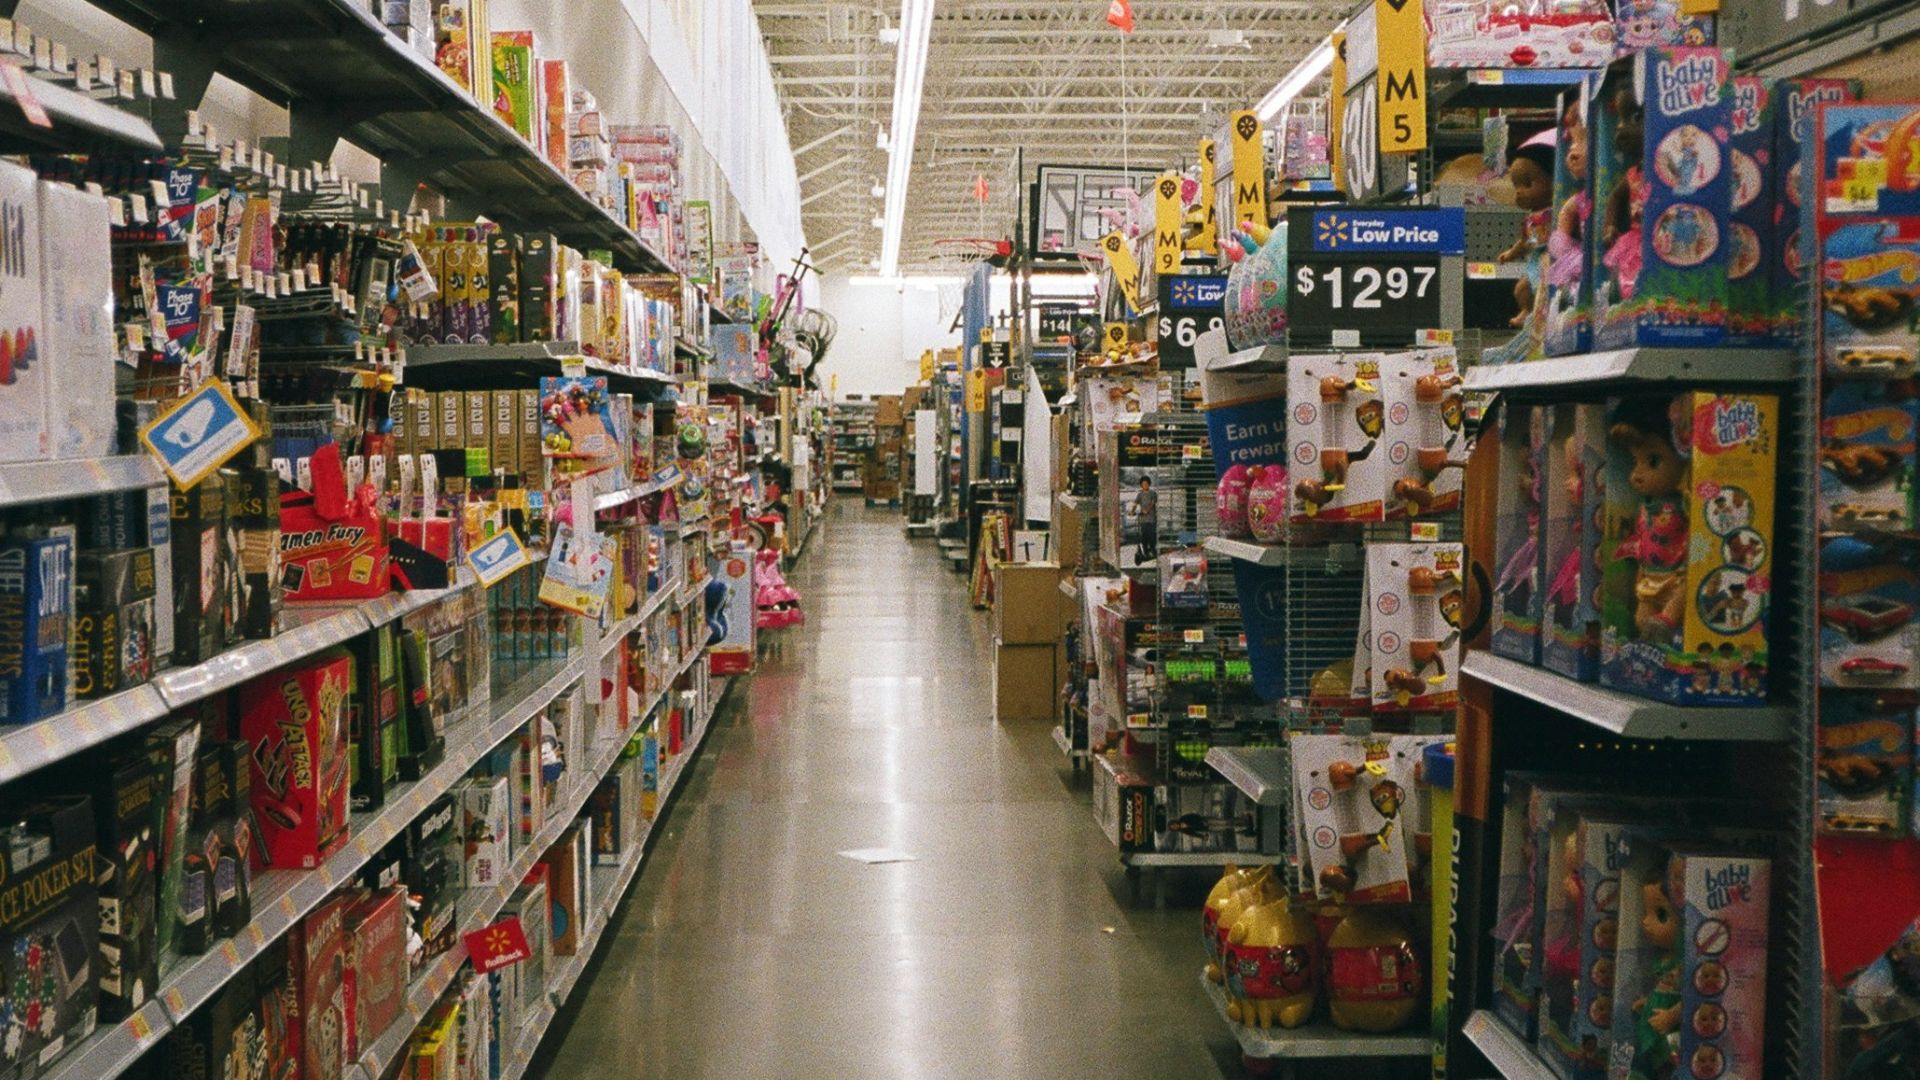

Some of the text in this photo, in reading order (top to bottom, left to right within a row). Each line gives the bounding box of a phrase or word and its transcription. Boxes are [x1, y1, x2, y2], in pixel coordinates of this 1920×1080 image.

[1660, 57, 1714, 88] baby
[1384, 69, 1418, 102] M
[1394, 114, 1411, 143] 5
[169, 169, 193, 185] Phase
[174, 184, 189, 197] 10
[1238, 182, 1260, 205] M
[1352, 219, 1385, 228] Everyday
[1158, 231, 1177, 248] M
[1352, 227, 1439, 243] Low Price
[1163, 254, 1173, 269] 9
[167, 289, 194, 307] Phase
[1197, 288, 1224, 302] Low
[173, 304, 189, 318] 10
[1225, 420, 1286, 442] Earn u
[281, 522, 365, 552] amen Fury
[65, 614, 95, 695] CHIPS
[277, 678, 314, 790] UNO ATTACK
[22, 858, 72, 914] POKER
[71, 843, 98, 884] SET
[1704, 862, 1751, 890] baby
[484, 948, 524, 970] Rollback
